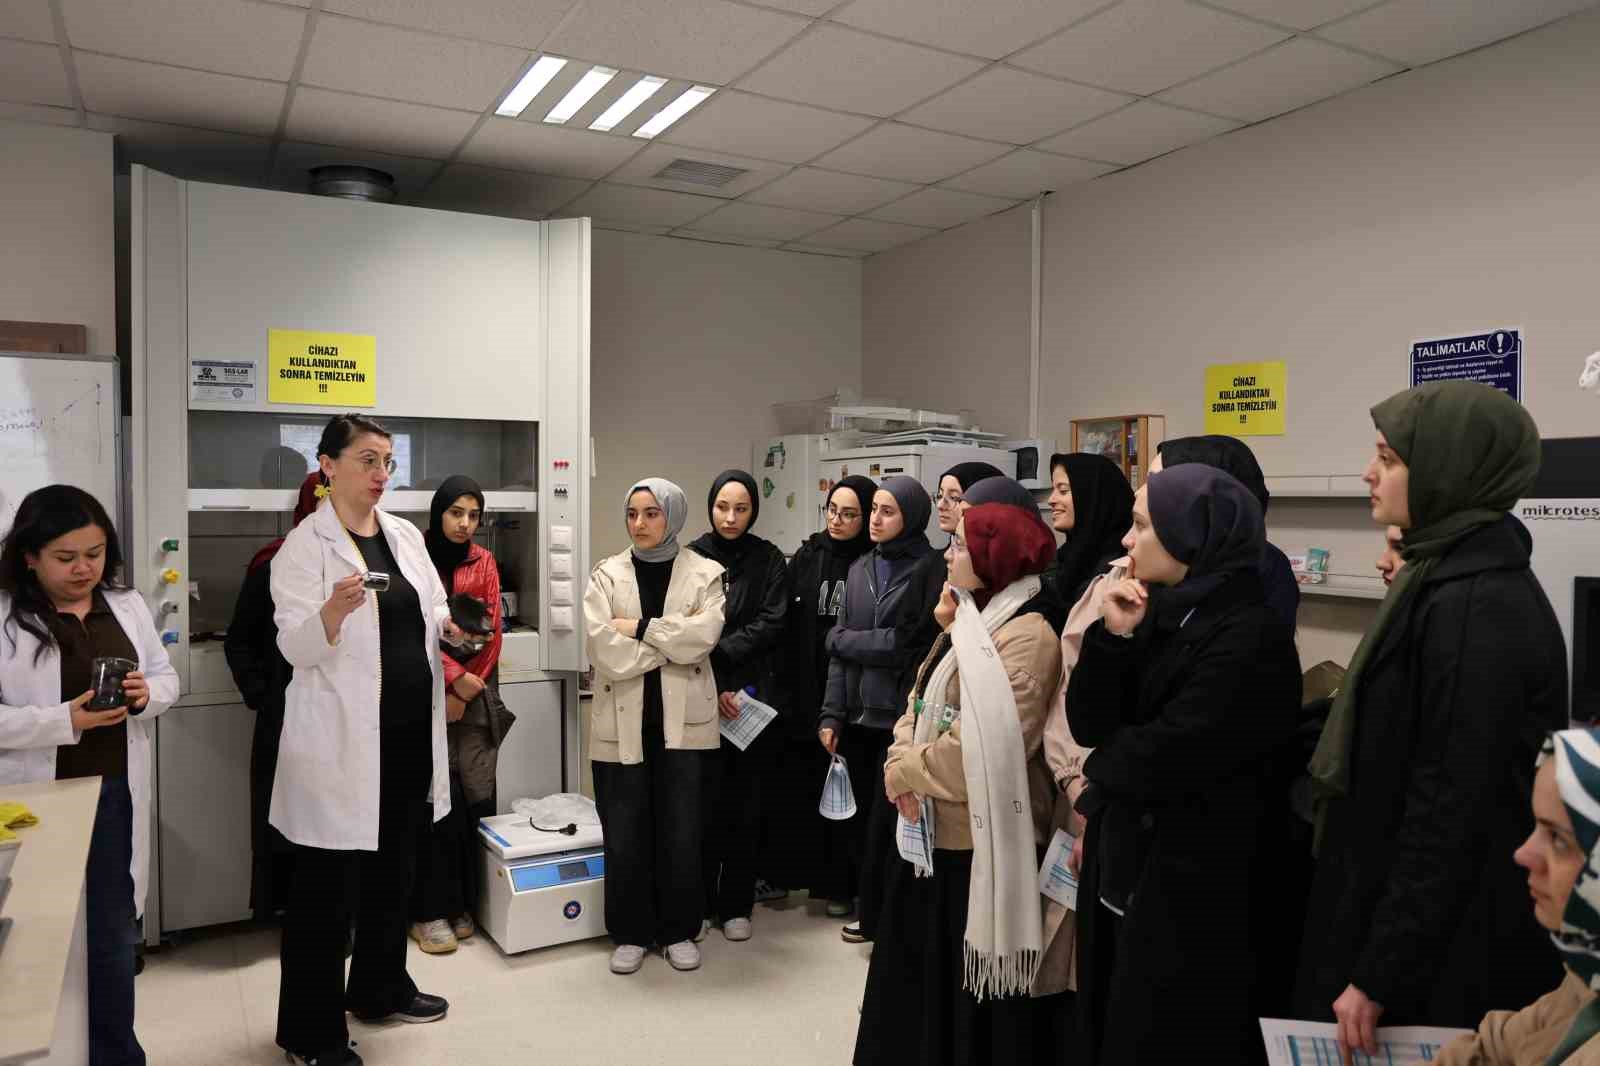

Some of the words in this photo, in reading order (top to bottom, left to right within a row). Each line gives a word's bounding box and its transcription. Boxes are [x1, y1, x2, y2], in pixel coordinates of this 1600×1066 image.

[308, 344, 338, 356] CİHAZI
[1416, 340, 1486, 358] TALİMATLAR
[289, 357, 357, 370] KULLANDIKTAN
[279, 368, 312, 380] SONRA
[314, 370, 366, 383] TEMİZLEYİN
[1233, 376, 1256, 387] CİHAZI
[1219, 388, 1270, 399] KULLANDIKTAN
[1212, 403, 1235, 412] SONRA
[1237, 400, 1277, 411] TEMİZLEYİN
